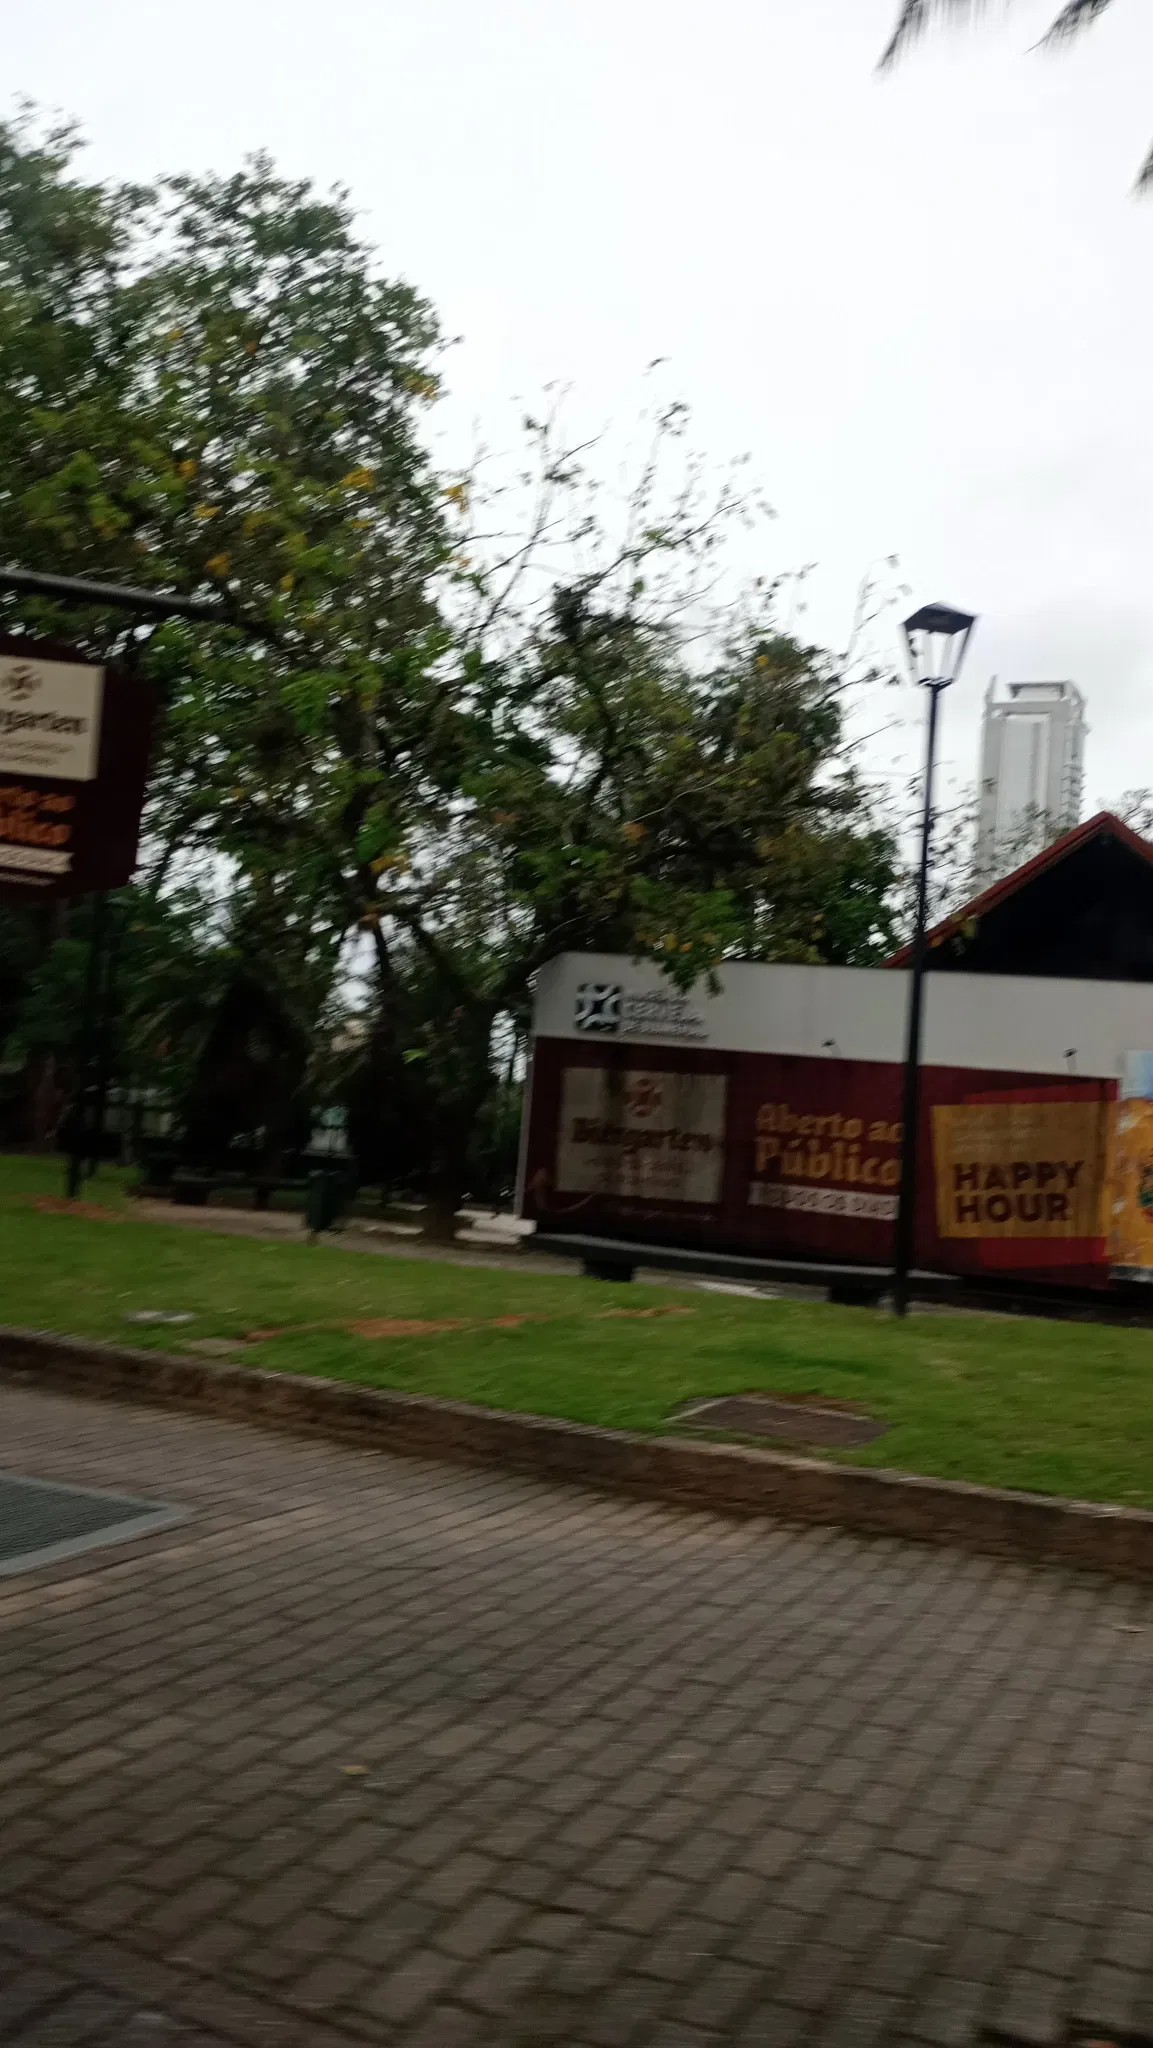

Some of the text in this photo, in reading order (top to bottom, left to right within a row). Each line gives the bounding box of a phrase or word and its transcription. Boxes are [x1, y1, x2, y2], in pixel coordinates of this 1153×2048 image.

[757, 1103, 863, 1139] Aberto
[756, 1136, 902, 1186] Público
[955, 1161, 1083, 1190] HAPPY
[957, 1194, 1069, 1223] HOUR
